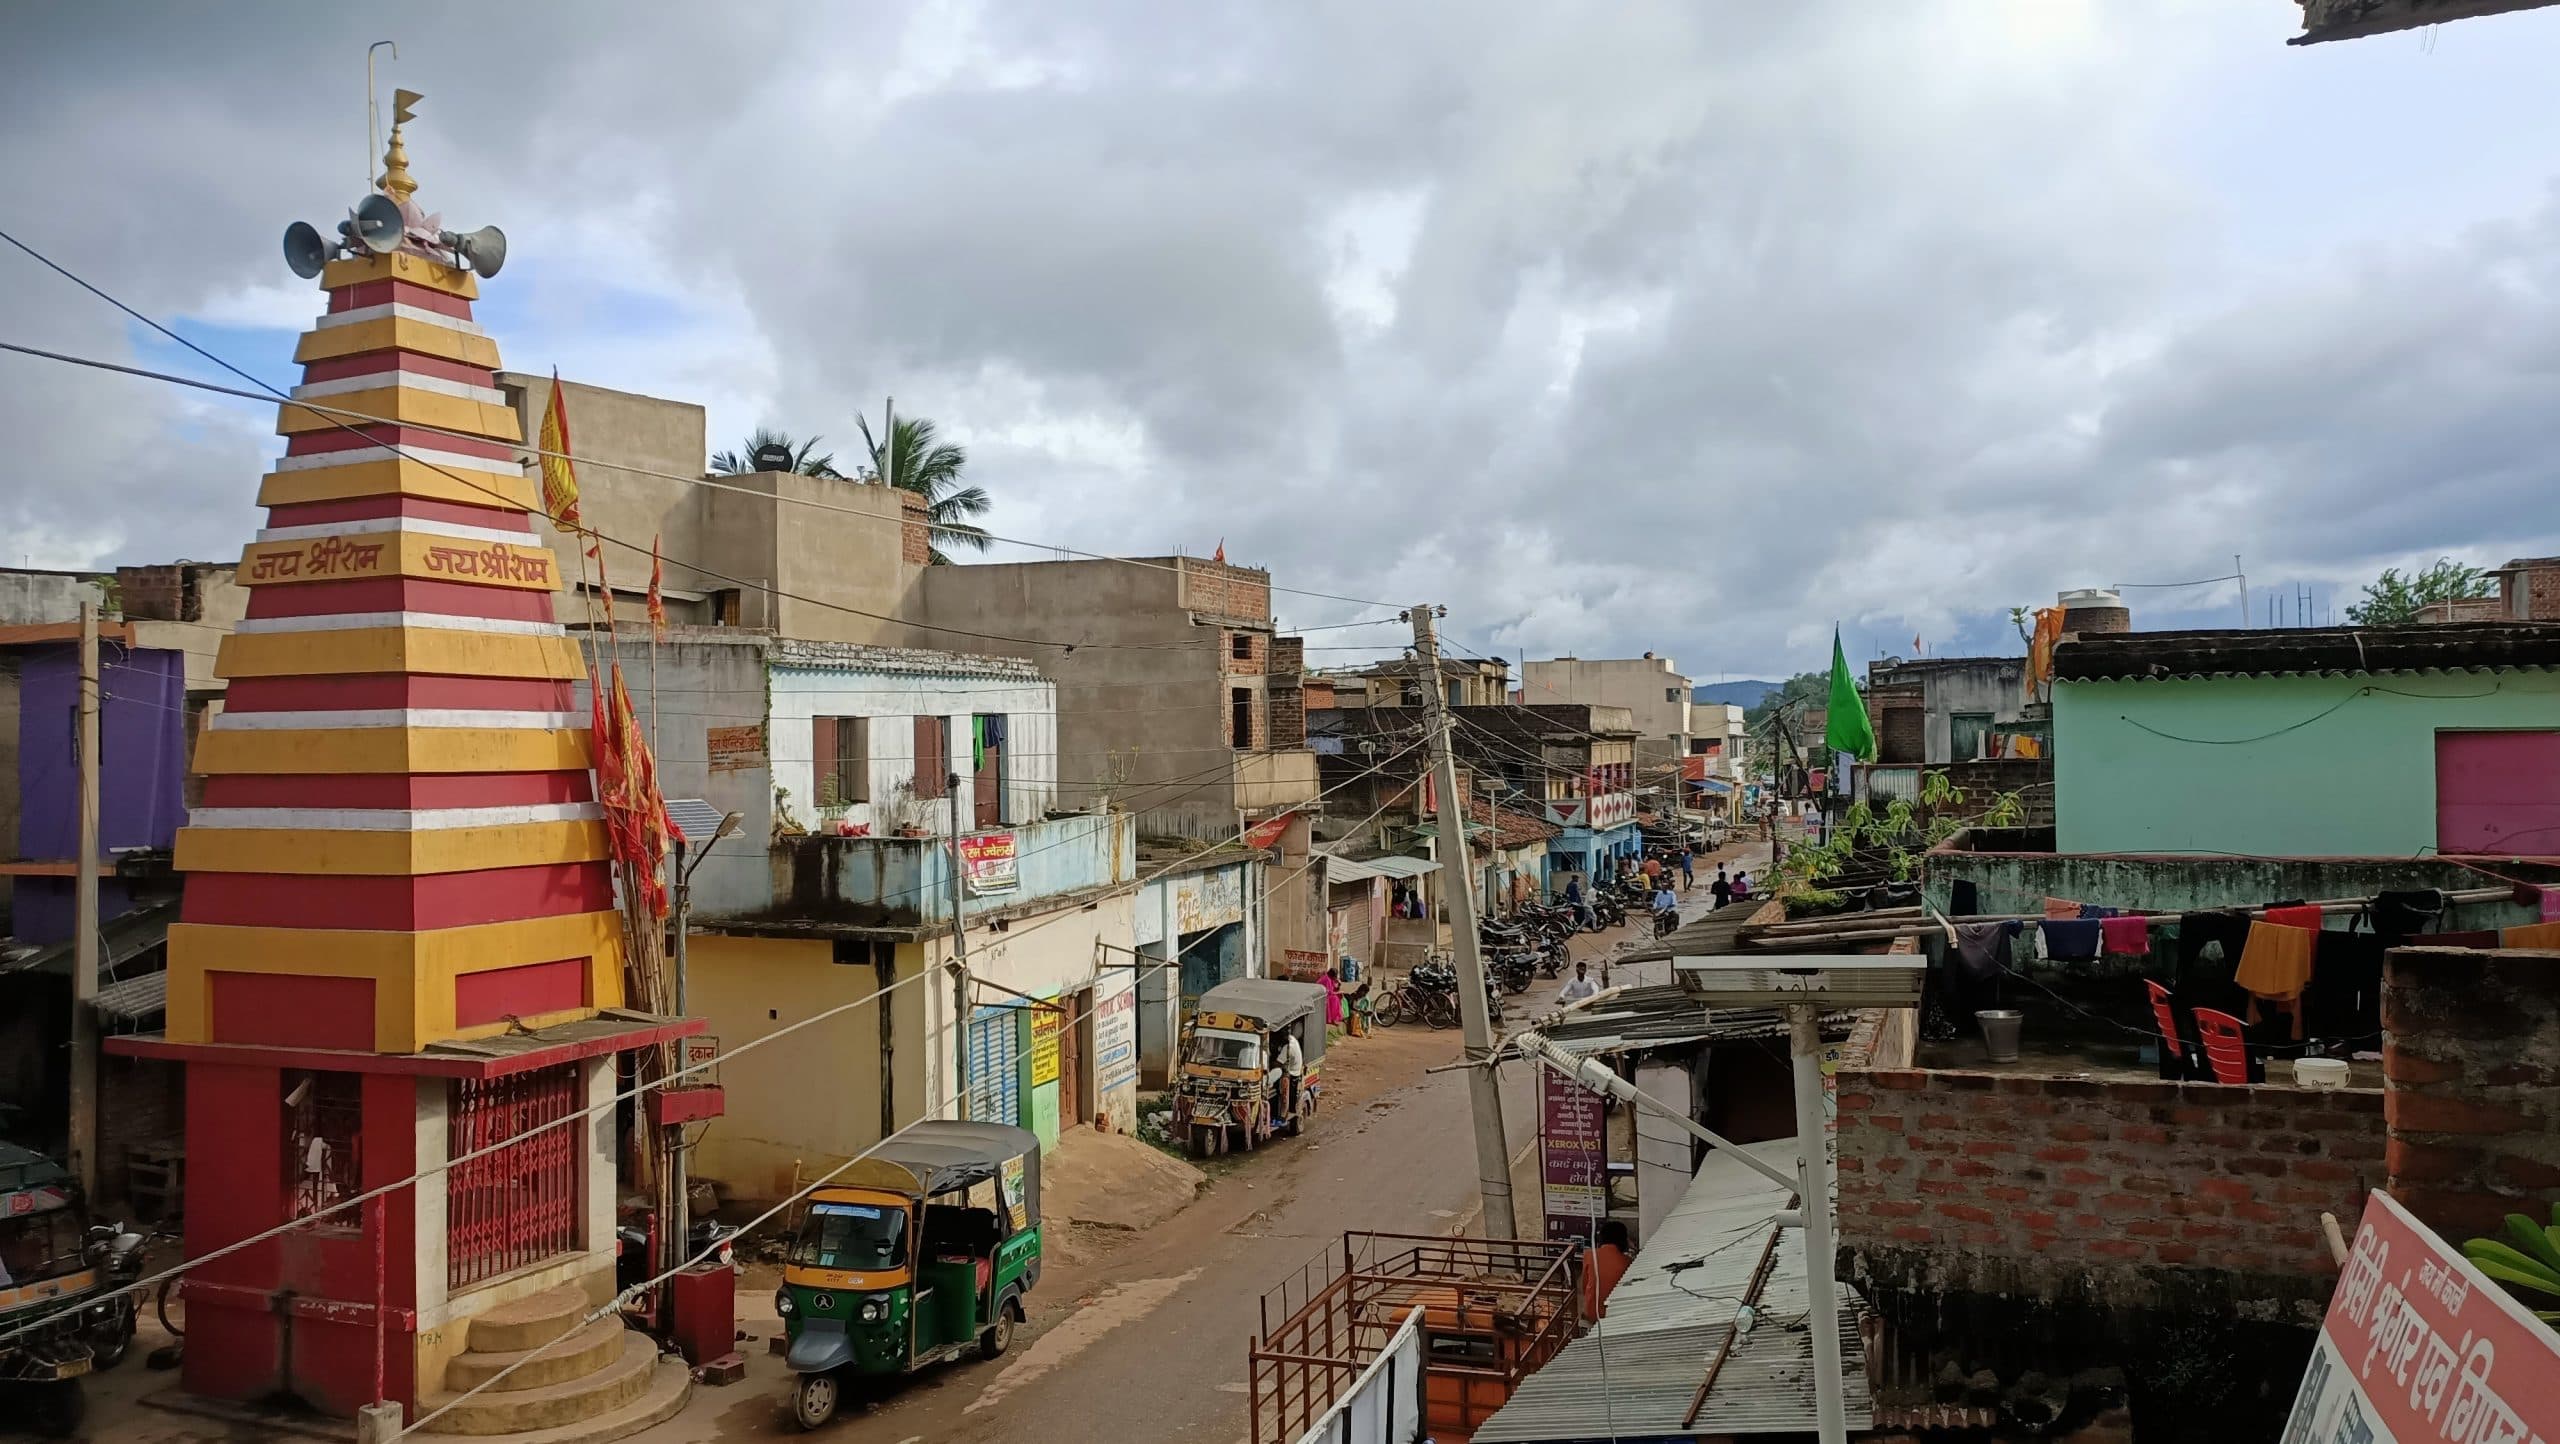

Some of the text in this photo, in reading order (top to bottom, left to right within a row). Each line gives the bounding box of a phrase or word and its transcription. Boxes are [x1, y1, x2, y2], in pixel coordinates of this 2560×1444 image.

[252, 550, 304, 579] जय
[423, 546, 479, 577] जय
[1548, 1140, 1580, 1150] XEROX
